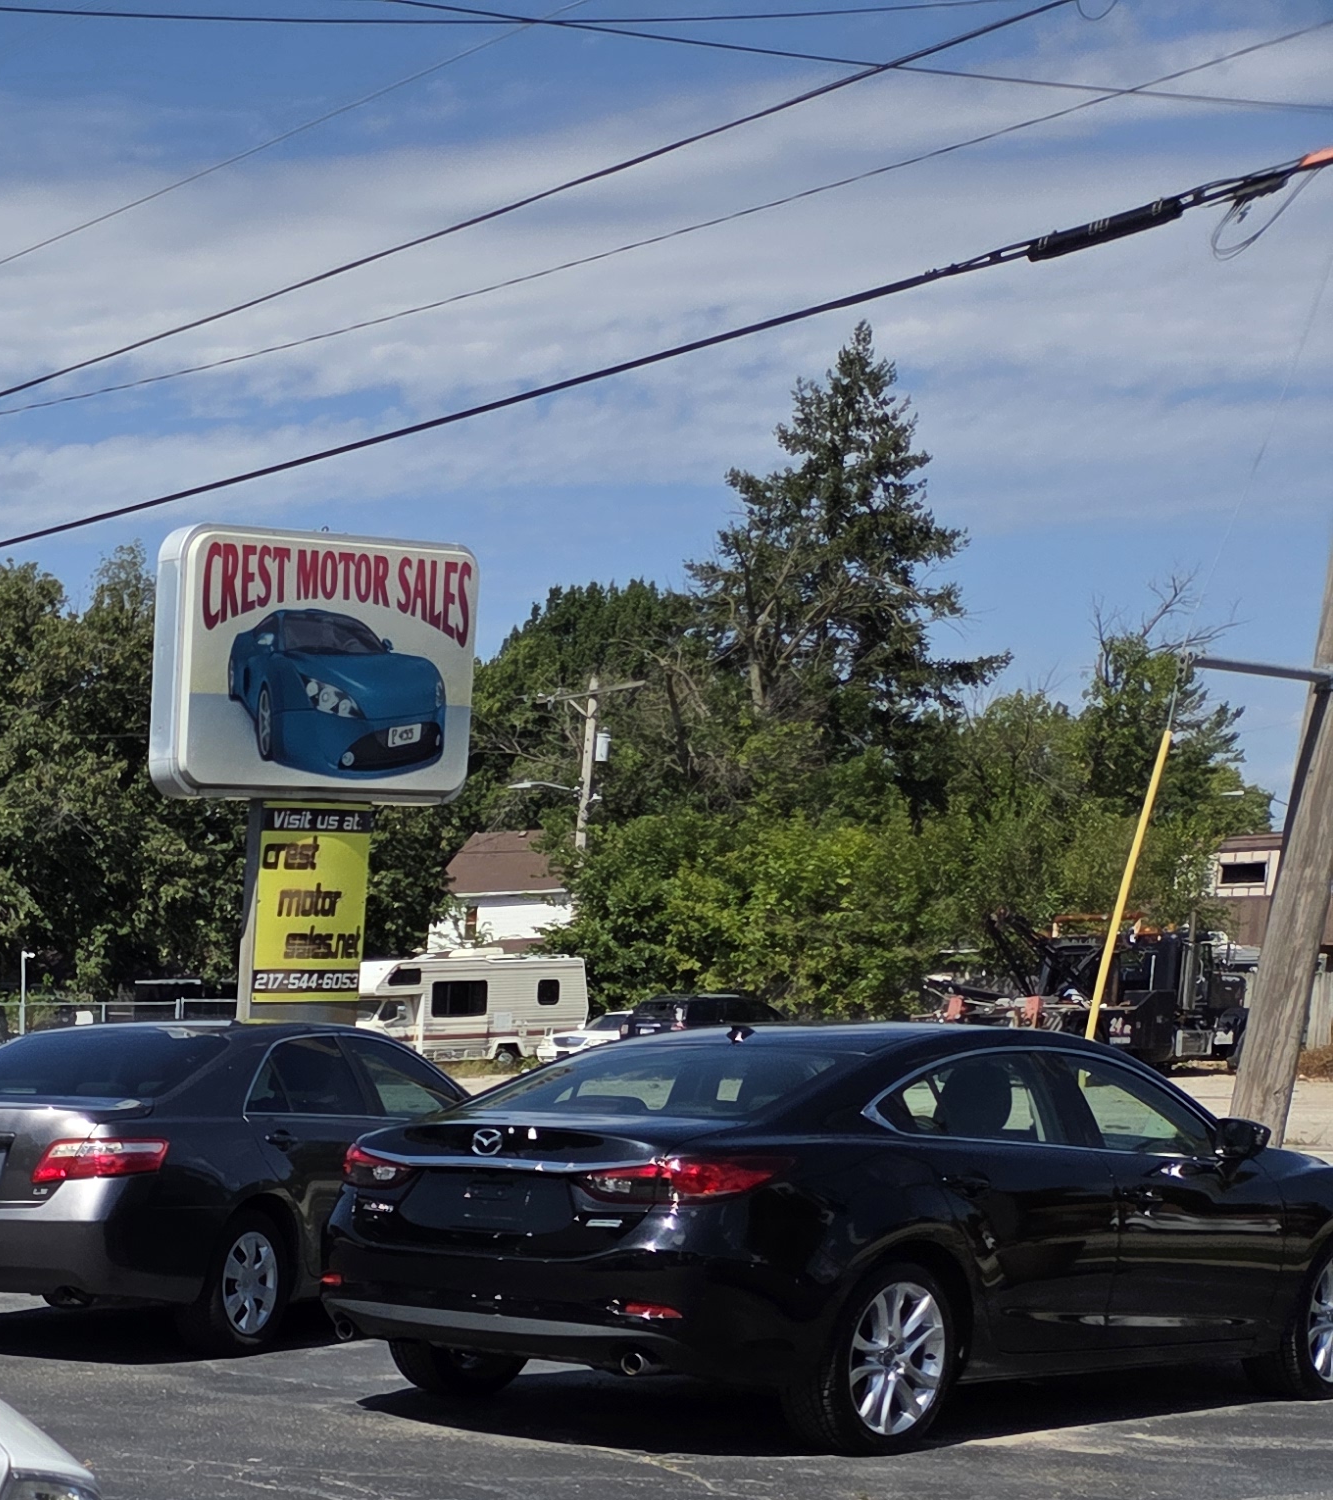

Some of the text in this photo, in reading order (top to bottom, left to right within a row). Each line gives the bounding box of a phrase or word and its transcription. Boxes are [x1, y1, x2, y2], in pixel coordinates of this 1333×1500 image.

[202, 542, 472, 648] CREST MOTOR SALES
[274, 811, 313, 829] Visit
[316, 815, 339, 829] us
[262, 835, 320, 870] crest
[277, 883, 342, 917] motor
[283, 925, 361, 959] sales.net
[254, 973, 359, 989] 217-544-6053
